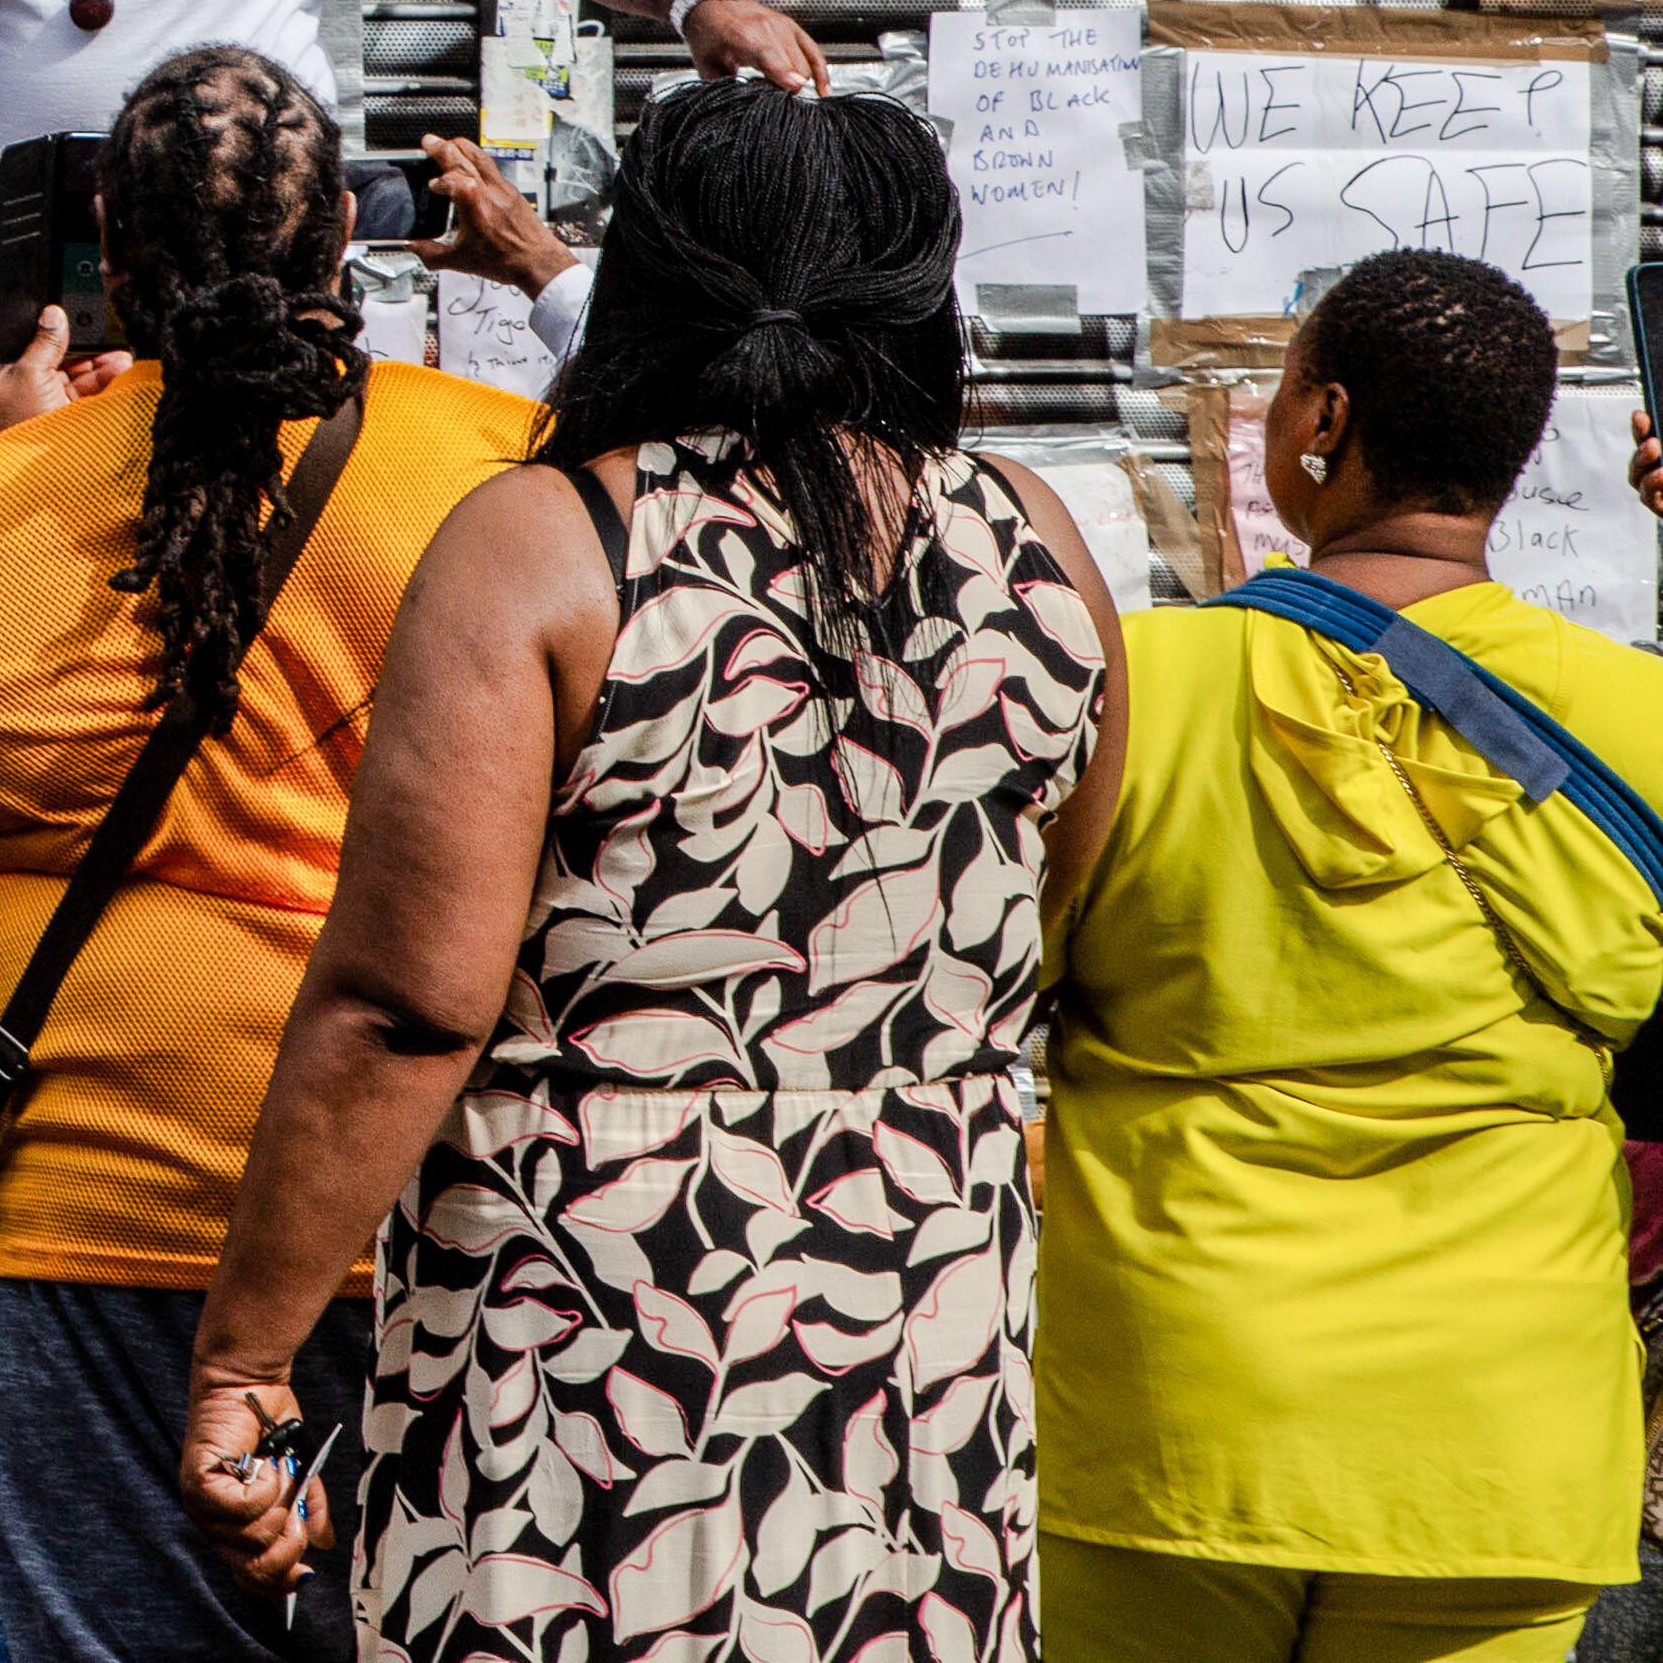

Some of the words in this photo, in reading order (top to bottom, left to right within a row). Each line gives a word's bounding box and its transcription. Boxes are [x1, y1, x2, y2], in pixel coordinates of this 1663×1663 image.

[1049, 28, 1097, 49] THE
[976, 91, 1005, 113] OF
[1190, 61, 1305, 154] WE
[1352, 58, 1563, 144] KEEP
[979, 119, 1040, 142] AND
[973, 149, 1054, 172] BROWN
[1221, 162, 1305, 254] US
[1340, 154, 1587, 270] SAFE
